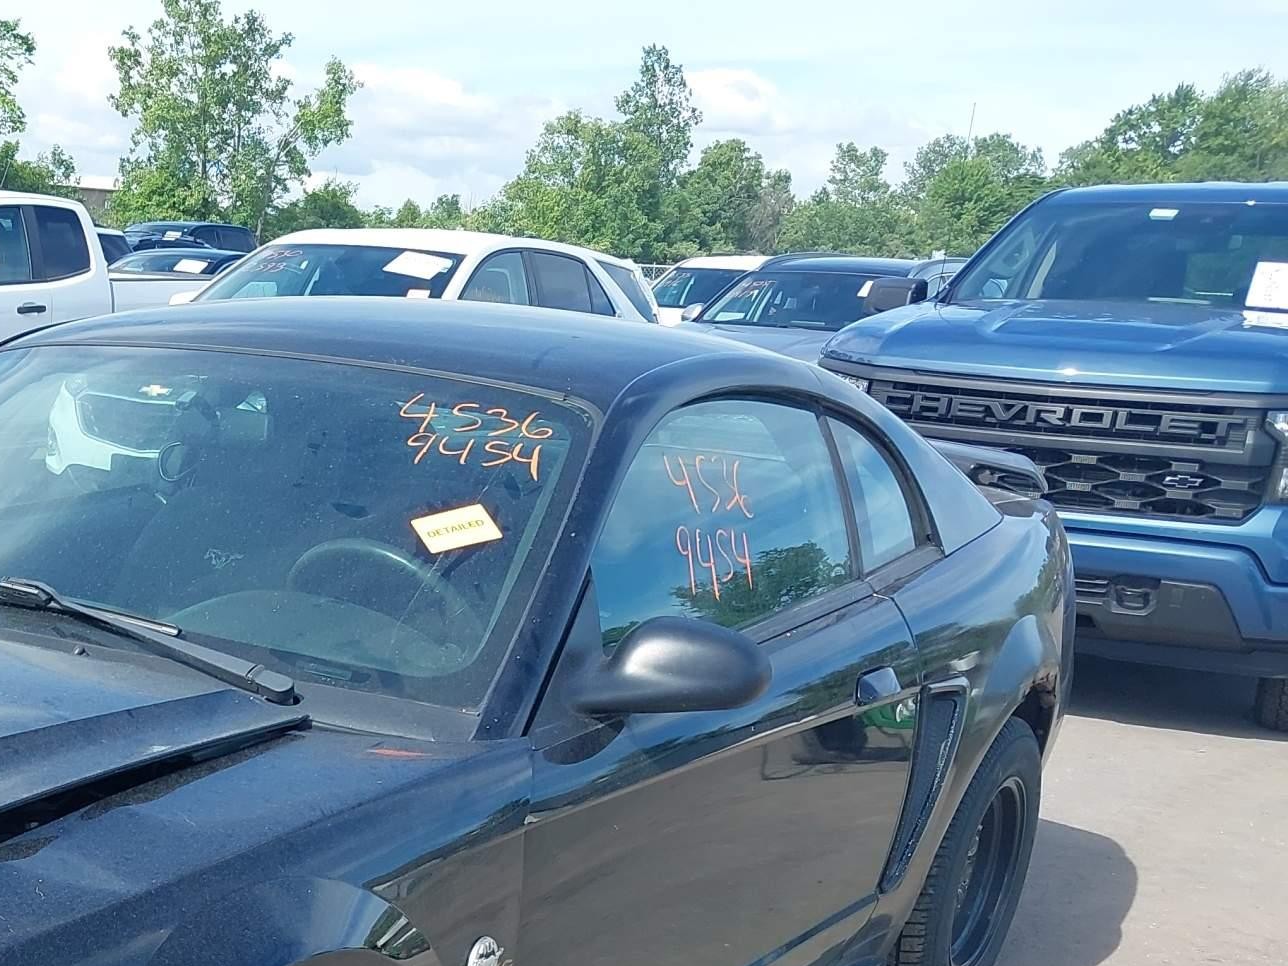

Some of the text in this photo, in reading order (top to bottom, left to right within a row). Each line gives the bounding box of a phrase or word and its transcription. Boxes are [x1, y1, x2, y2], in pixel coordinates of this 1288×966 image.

[399, 393, 553, 439] 4536
[880, 390, 1245, 438] CHEVROLET
[407, 432, 543, 481] 9454
[426, 518, 485, 539] DETAILED
[676, 525, 753, 602] 9454
